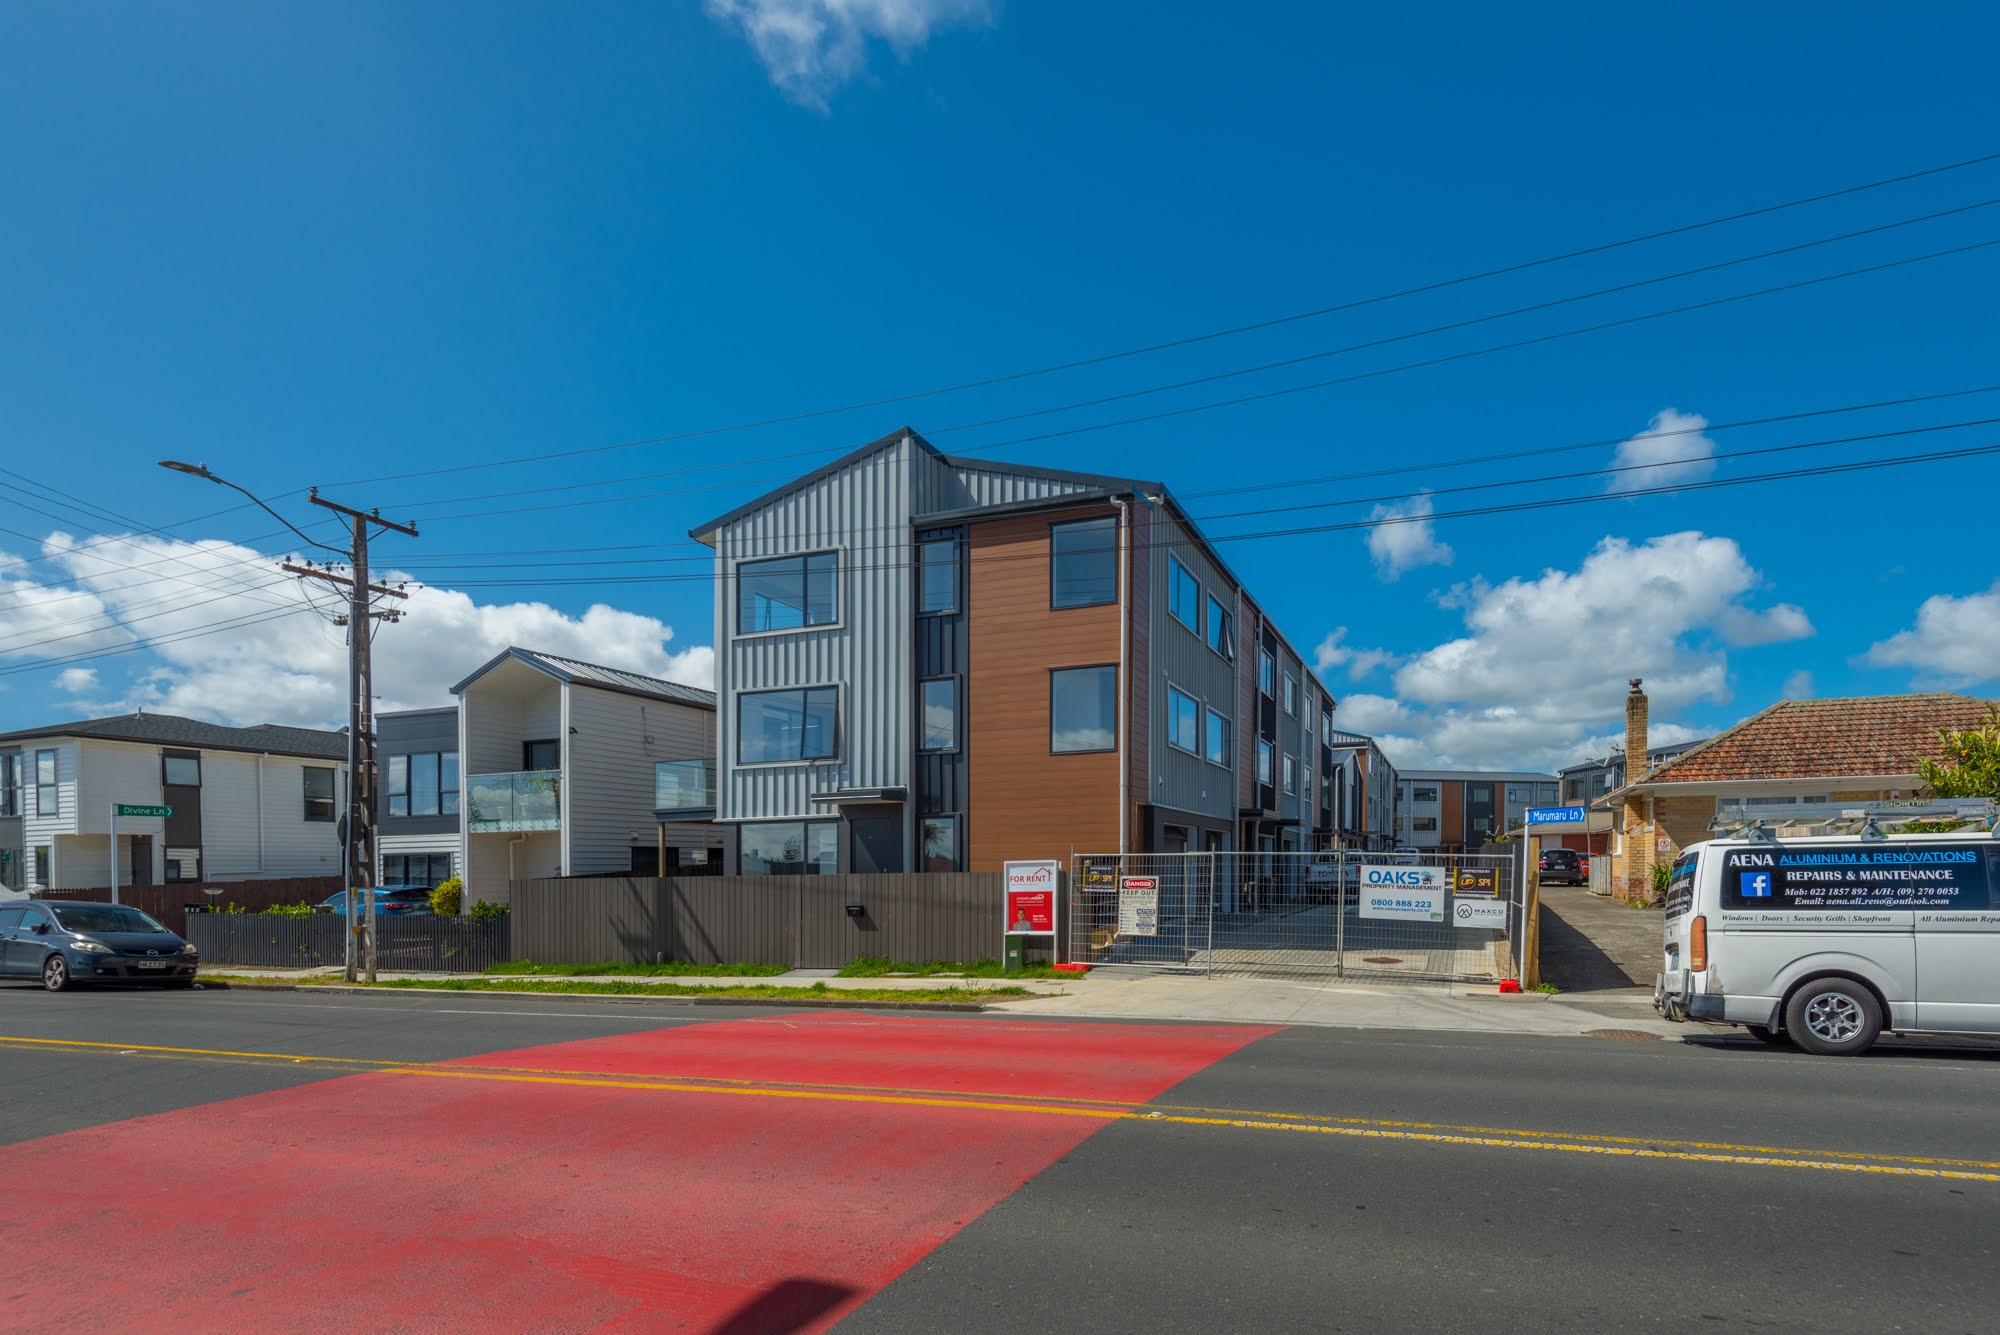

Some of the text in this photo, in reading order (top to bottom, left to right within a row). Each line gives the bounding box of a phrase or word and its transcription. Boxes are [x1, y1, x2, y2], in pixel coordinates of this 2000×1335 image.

[124, 807, 151, 815] Divine
[1533, 809, 1579, 821] Marumaru Ln
[1729, 854, 1775, 867] AENA
[1780, 851, 1977, 865] ALUMINIUM & RENOVATIONS
[1009, 875, 1046, 883] FOR RENT
[1318, 870, 1349, 878] TOYOA
[1368, 870, 1420, 885] OAKS
[1786, 869, 1954, 881] REPAIRS & MAINTENANCE
[1478, 878, 1491, 887] SPI
[1784, 888, 1808, 896] Mob:
[1809, 888, 1826, 896] 022
[1828, 888, 1849, 896] 1857
[1851, 888, 1868, 896] 892
[1872, 888, 1895, 896] A/H:
[1897, 887, 1915, 897] (09)
[1936, 887, 1960, 895] 0053
[1371, 899, 1393, 907] 0800
[1415, 901, 1432, 909] 223
[1722, 914, 1892, 924] Windows Doors Security Grills Shopfront
[1919, 915, 1932, 923] All
[1933, 915, 1979, 923] Aluminium
